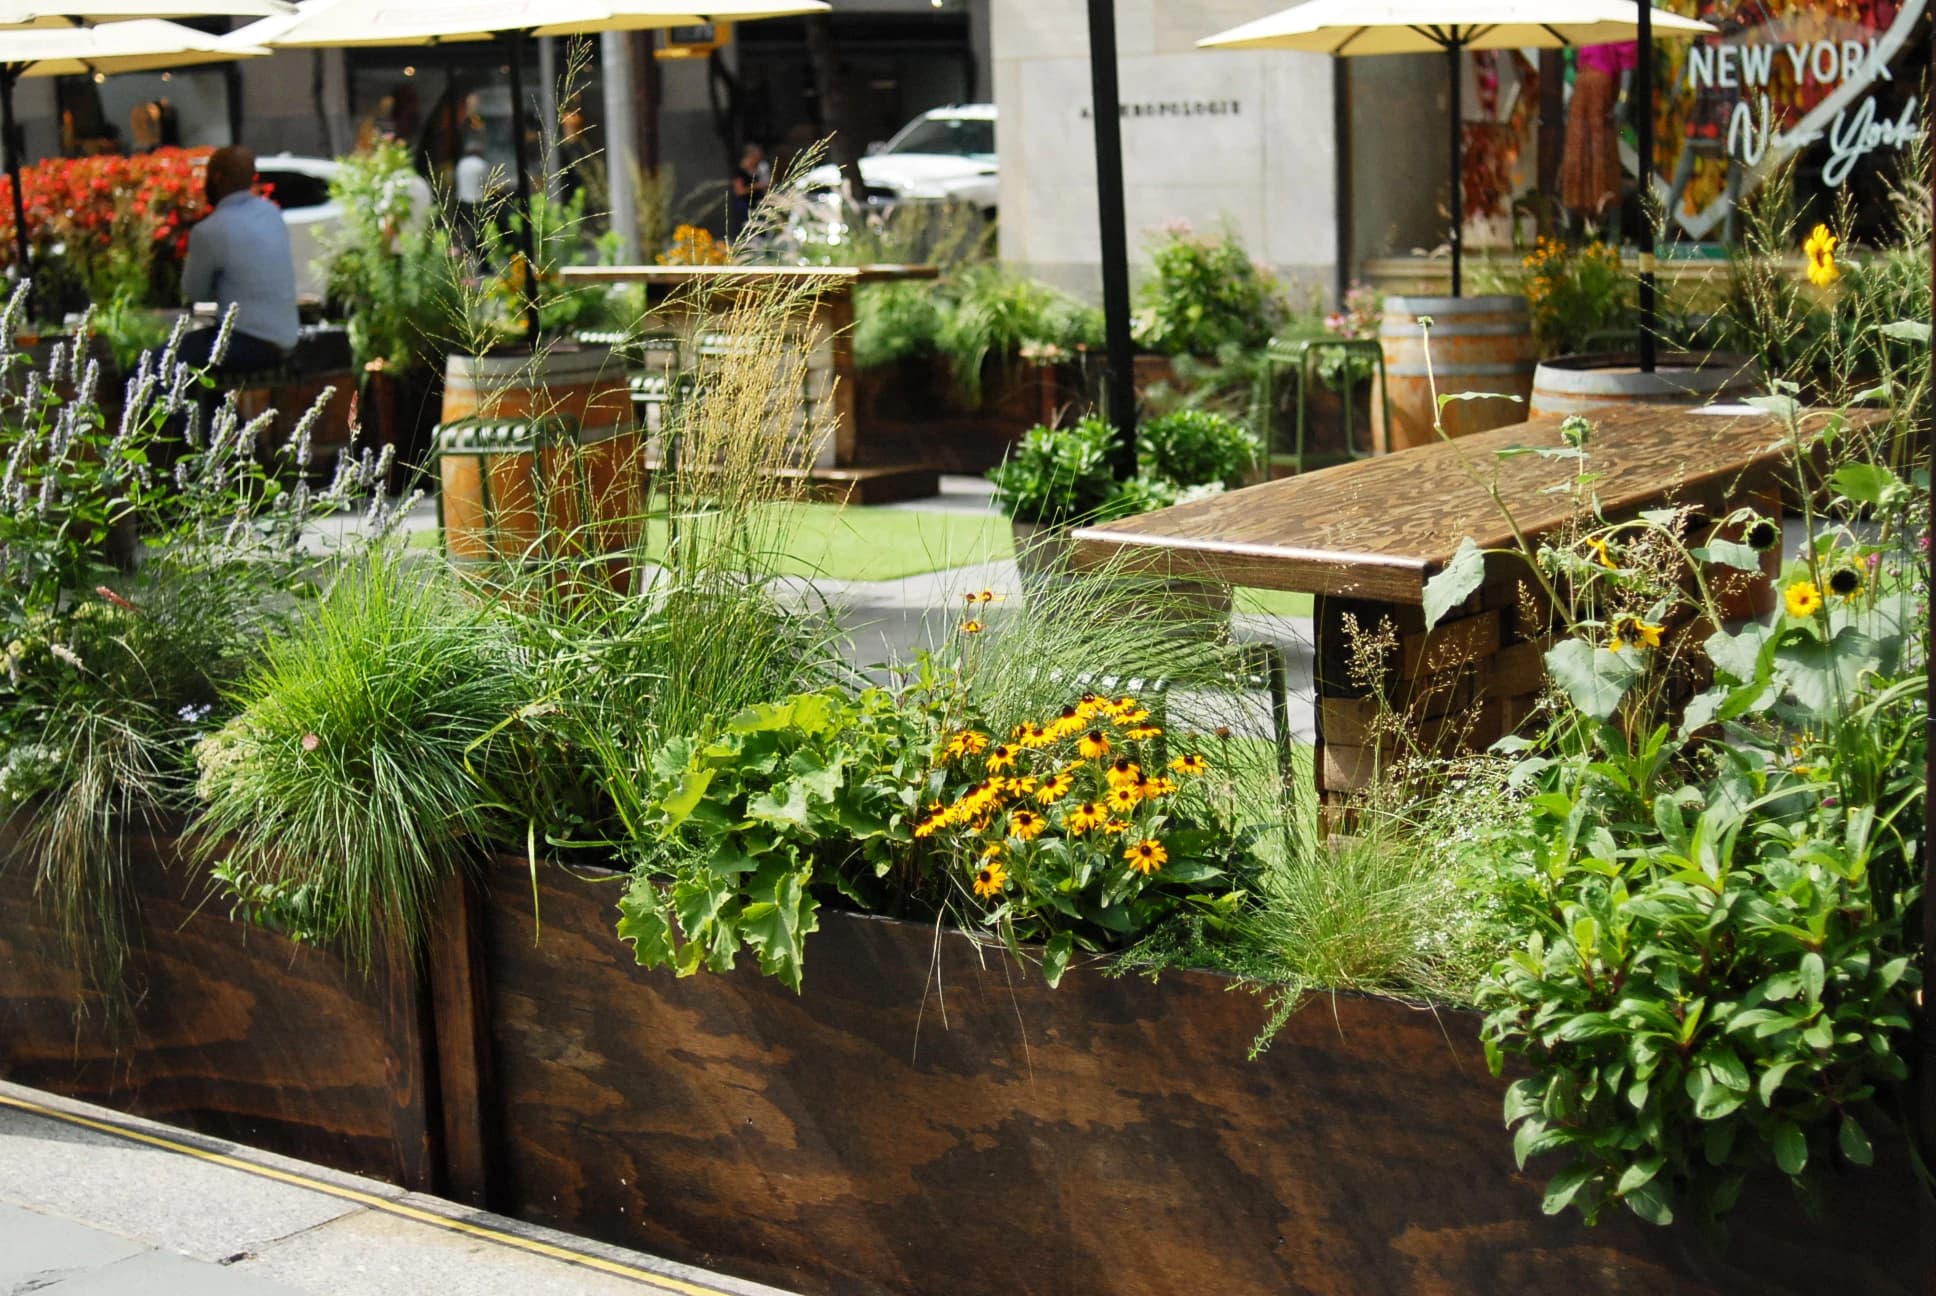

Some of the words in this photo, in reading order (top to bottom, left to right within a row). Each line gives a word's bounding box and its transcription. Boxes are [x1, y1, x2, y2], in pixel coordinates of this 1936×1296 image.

[1688, 43, 1773, 88] NEW
[1786, 38, 1892, 85] YORK
[1081, 101, 1240, 118] AHROPOLOGIE
[1822, 95, 1926, 187] York
